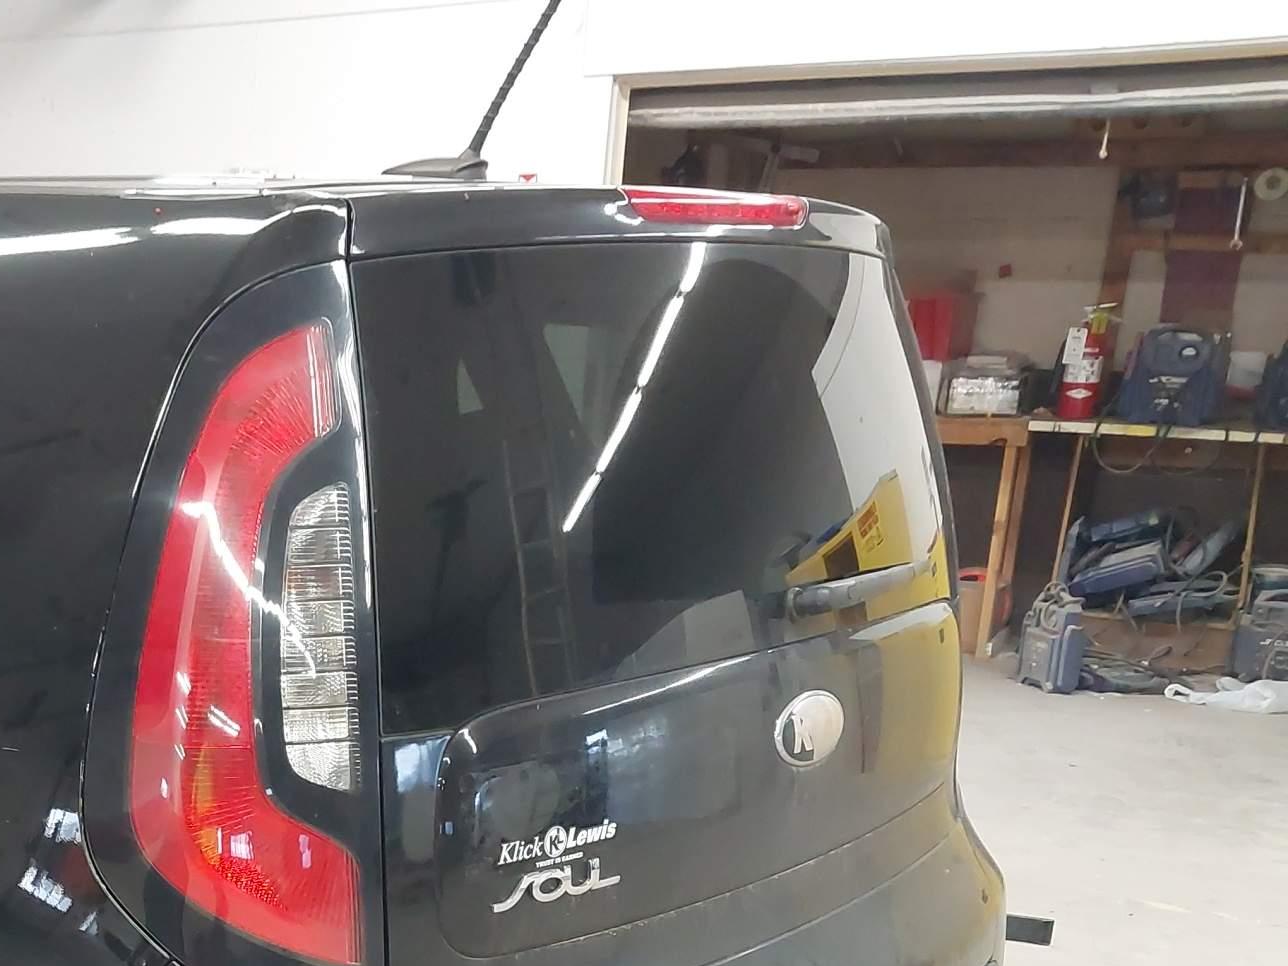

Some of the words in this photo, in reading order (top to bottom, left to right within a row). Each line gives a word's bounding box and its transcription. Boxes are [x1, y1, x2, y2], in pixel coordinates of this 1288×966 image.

[497, 835, 544, 865] Klick
[566, 818, 617, 849] Lewis
[492, 857, 621, 913] SOUL
